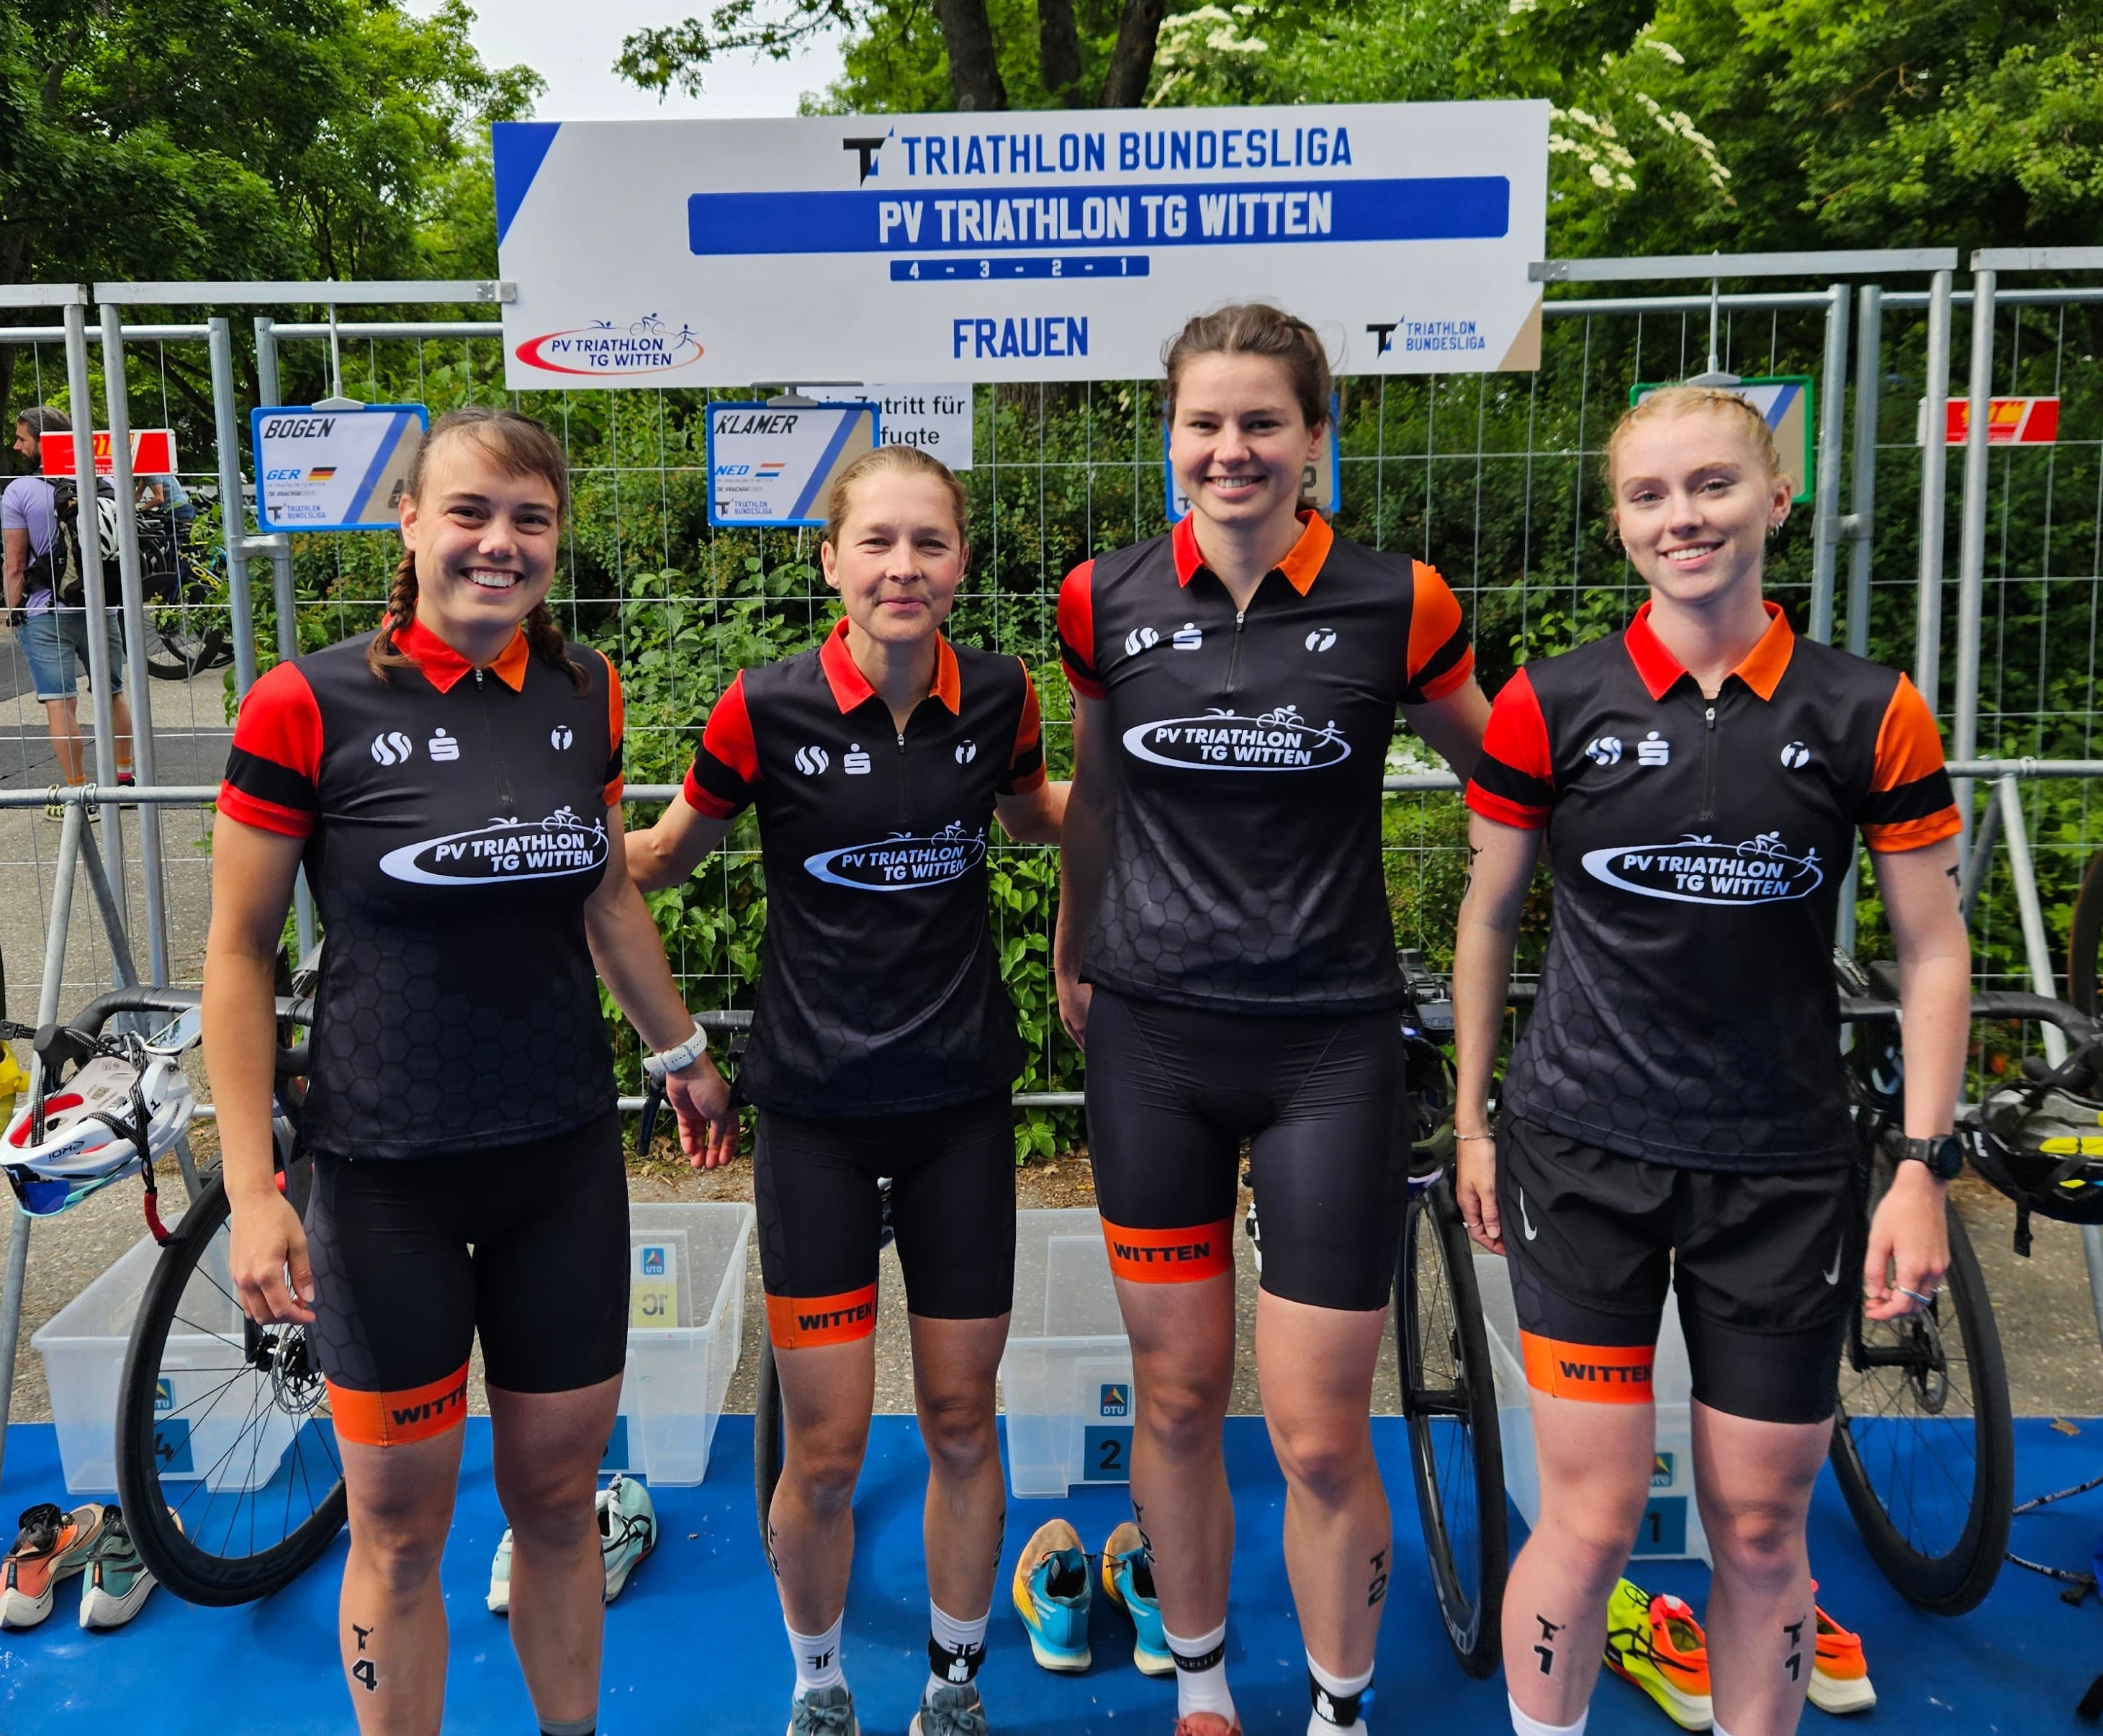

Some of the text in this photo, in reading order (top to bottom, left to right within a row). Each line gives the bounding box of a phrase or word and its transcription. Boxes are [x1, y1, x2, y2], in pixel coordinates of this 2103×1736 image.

[901, 132, 1105, 175] TRIATHLON
[1120, 127, 1352, 171] BUNDESLIGA
[878, 192, 1333, 243] PV TRIATHLON TG WITTEN
[909, 261, 920, 279] 4
[979, 261, 990, 277] 3
[1051, 259, 1062, 276] 2
[1120, 258, 1127, 274] 1
[953, 316, 1089, 359] FRAUEN
[1406, 321, 1475, 336] TRIATHLON
[551, 338, 663, 352] PV TRIATHLON
[1406, 336, 1485, 351] BUNDESLIGA
[590, 354, 672, 366] TG WITTEN
[933, 396, 965, 415] für
[264, 418, 336, 439] BOGEN
[716, 415, 798, 434] KLAMER
[266, 469, 301, 480] GER
[715, 465, 749, 475] NED
[1155, 727, 1302, 748] PV TRIATHLON
[1200, 745, 1312, 765] TG WITTEN
[435, 834, 585, 863] PV TRIATHLON
[841, 845, 965, 868] PV TRIATHLON
[491, 850, 593, 873] TG WITTEN
[883, 858, 967, 882] TG WITTEN
[1623, 854, 1784, 878] PV TRIATHLON
[1675, 874, 1791, 896] TG WITTEN
[1113, 1241, 1210, 1263] WITTEN
[798, 1302, 873, 1331] WITTEN
[154, 1399, 171, 1408] TU
[1103, 1406, 1125, 1415] DTU
[1100, 1439, 1121, 1470] 2
[1647, 1511, 1661, 1544] 1
[352, 1658, 378, 1692] 4
